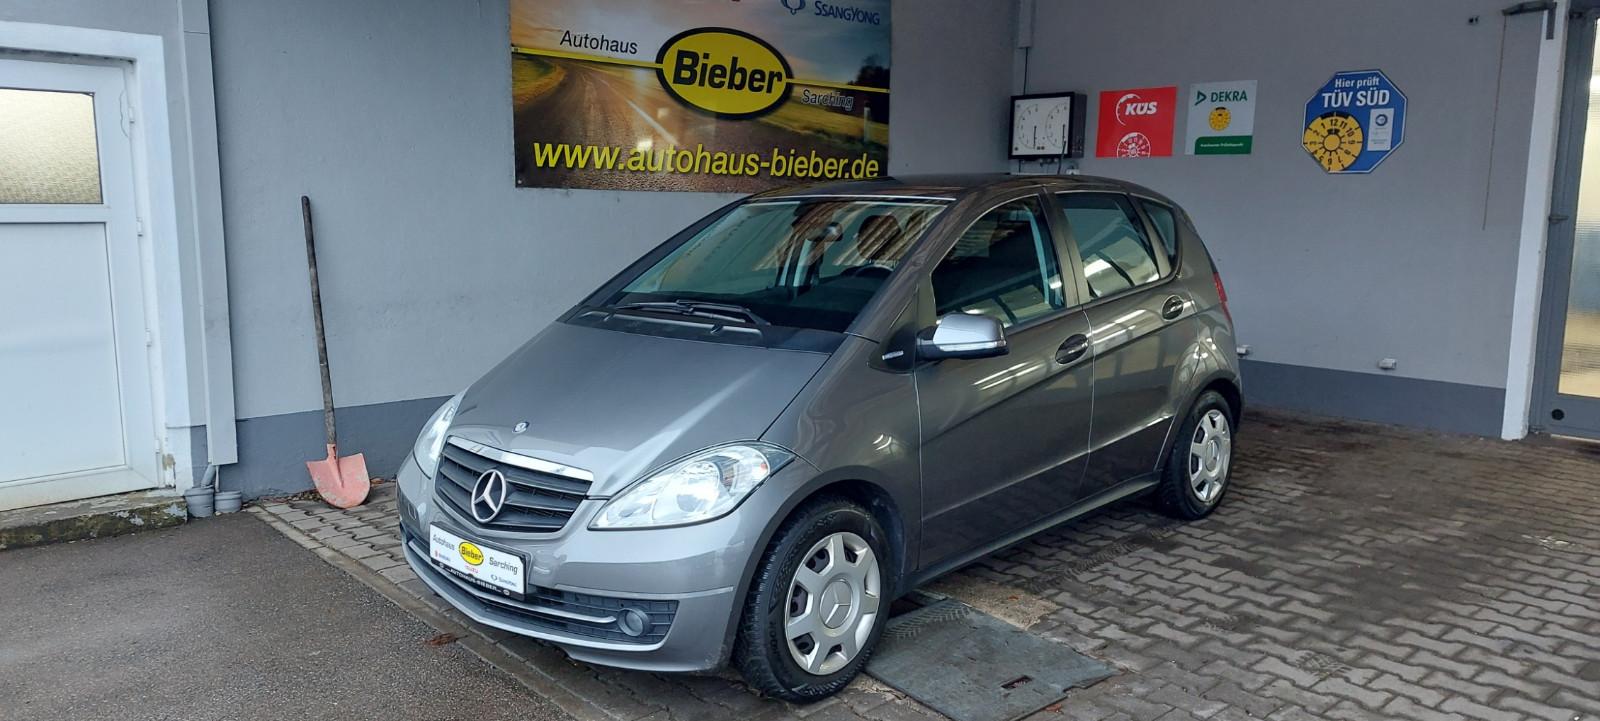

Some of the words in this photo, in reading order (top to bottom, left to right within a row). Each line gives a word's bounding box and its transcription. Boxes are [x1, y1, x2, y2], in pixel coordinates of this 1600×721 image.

[560, 30, 638, 55] Autohaus
[672, 49, 783, 93] Bieber
[1335, 78, 1355, 88] Hier
[1356, 76, 1380, 89] prüft
[801, 89, 854, 111] Sarching
[1210, 90, 1248, 103] DEKRA
[1322, 89, 1353, 108] TÜV
[1356, 87, 1390, 106] SÜD
[1124, 100, 1158, 116] KÜS
[1330, 118, 1338, 126] 12
[533, 142, 879, 180] www.autohaus-bieber.de
[433, 534, 455, 551] Autohaus
[461, 546, 482, 561] Bieber
[489, 557, 519, 575] Sarching
